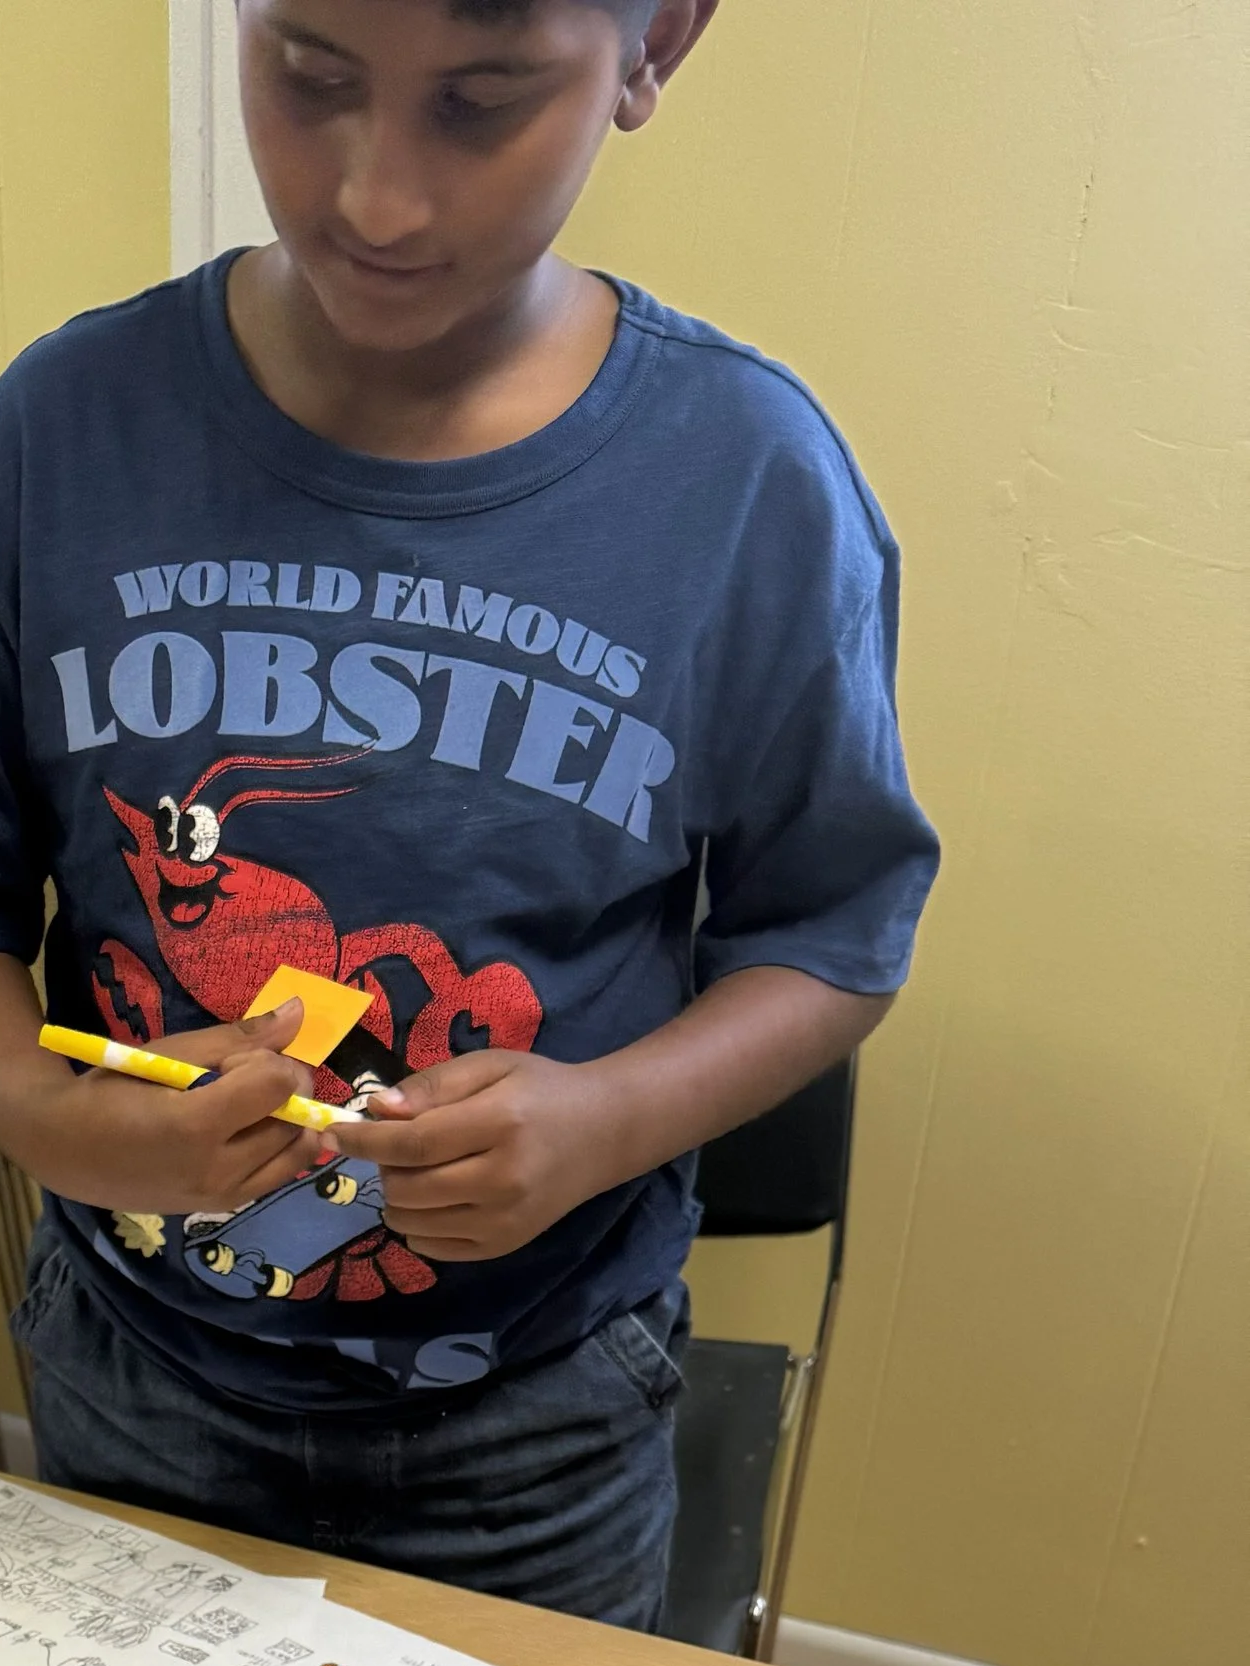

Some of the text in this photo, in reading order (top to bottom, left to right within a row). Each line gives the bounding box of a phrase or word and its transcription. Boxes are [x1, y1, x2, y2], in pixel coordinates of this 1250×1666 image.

[113, 559, 647, 699] WORLD FAMOUS
[50, 630, 677, 843] LOBSTER
